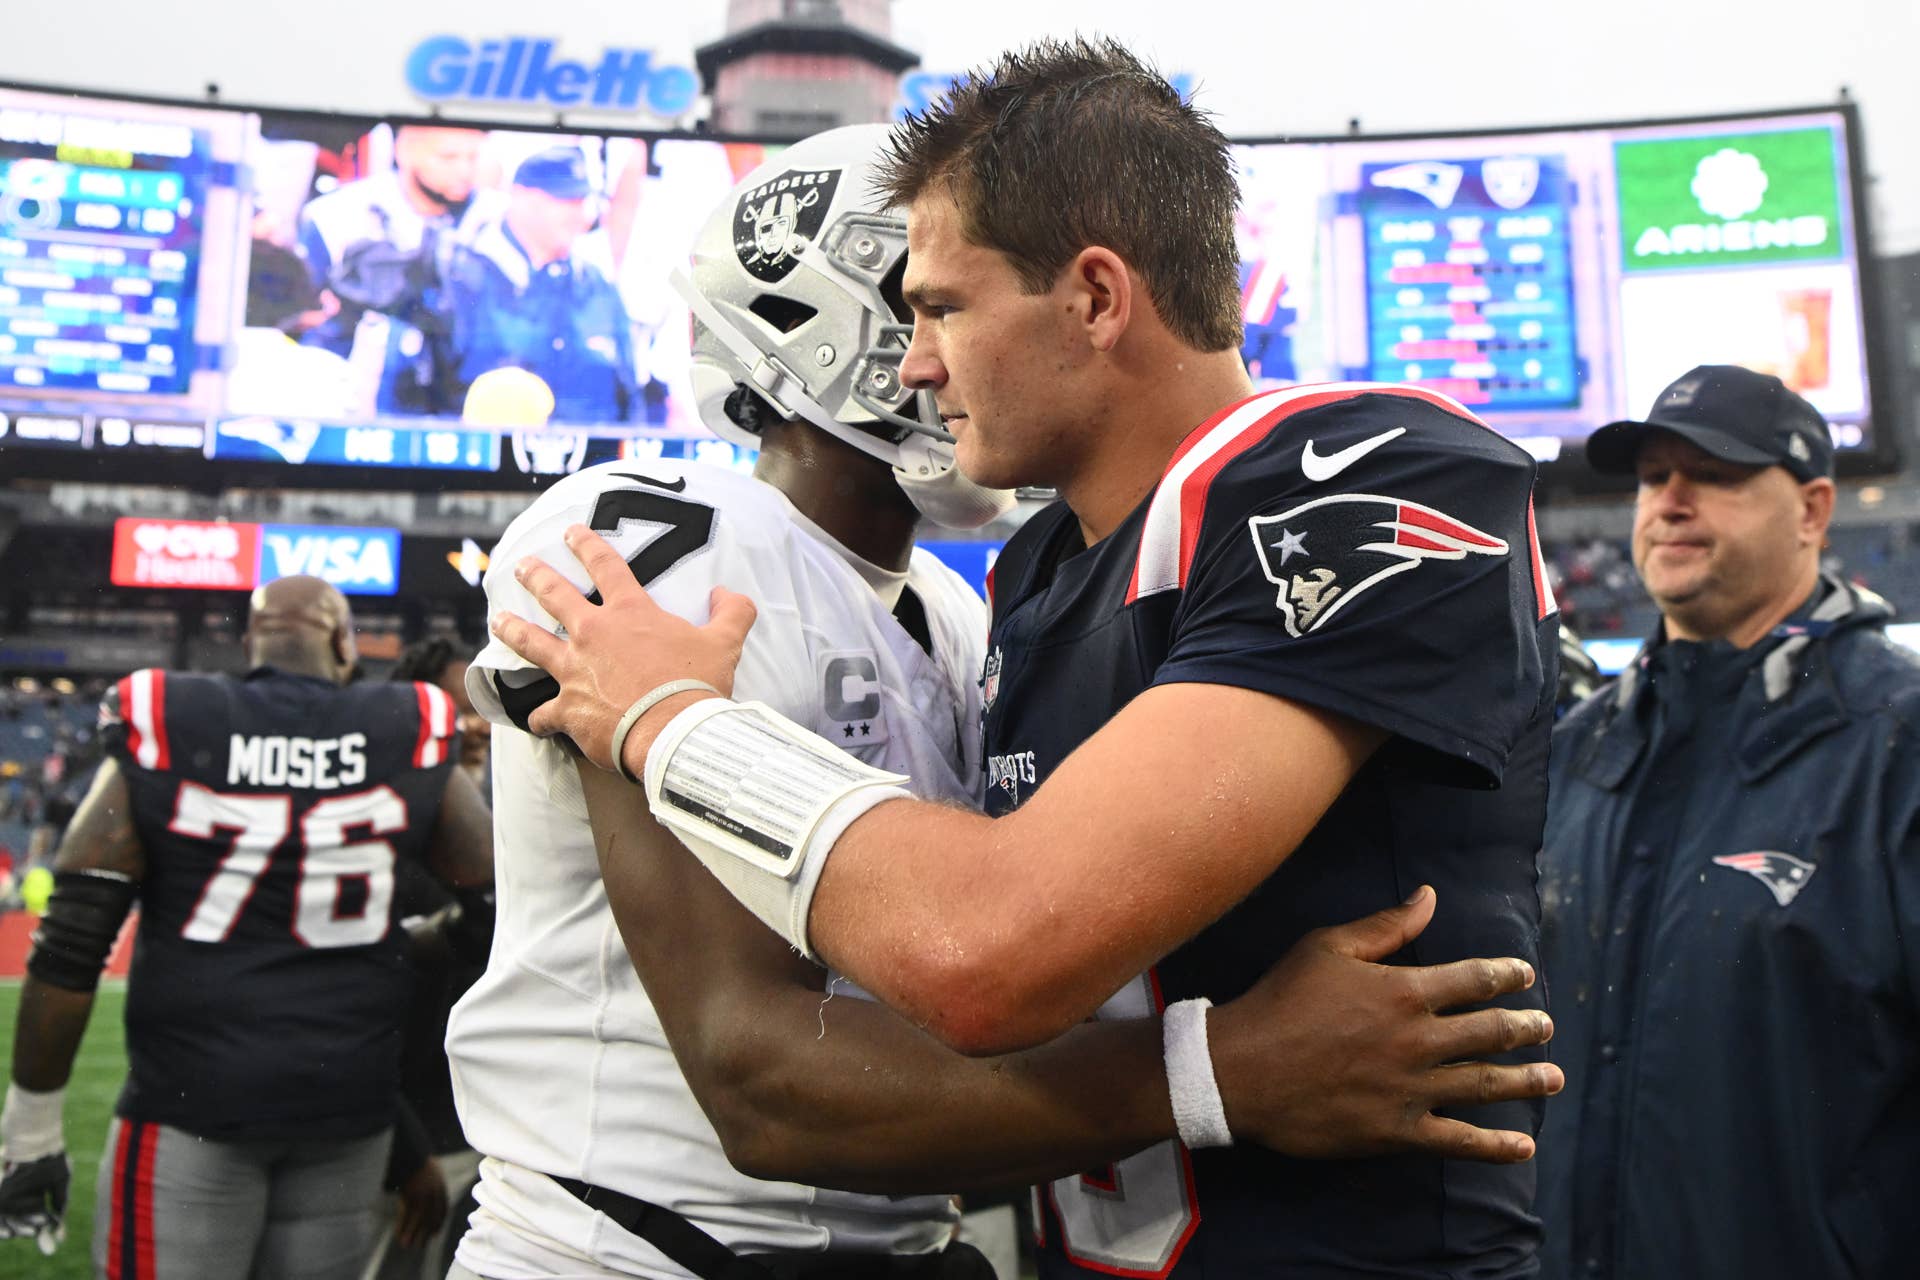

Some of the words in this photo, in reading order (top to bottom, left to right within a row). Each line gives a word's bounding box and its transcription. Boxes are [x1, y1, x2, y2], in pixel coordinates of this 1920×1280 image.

[405, 35, 698, 115] Gillette
[744, 172, 830, 202] RAIDERS
[1633, 215, 1828, 257] ARIENS
[265, 533, 394, 585] VISA
[585, 486, 720, 606] 7
[823, 656, 881, 722] C
[228, 733, 366, 788] MOSES
[168, 780, 408, 948] 76
